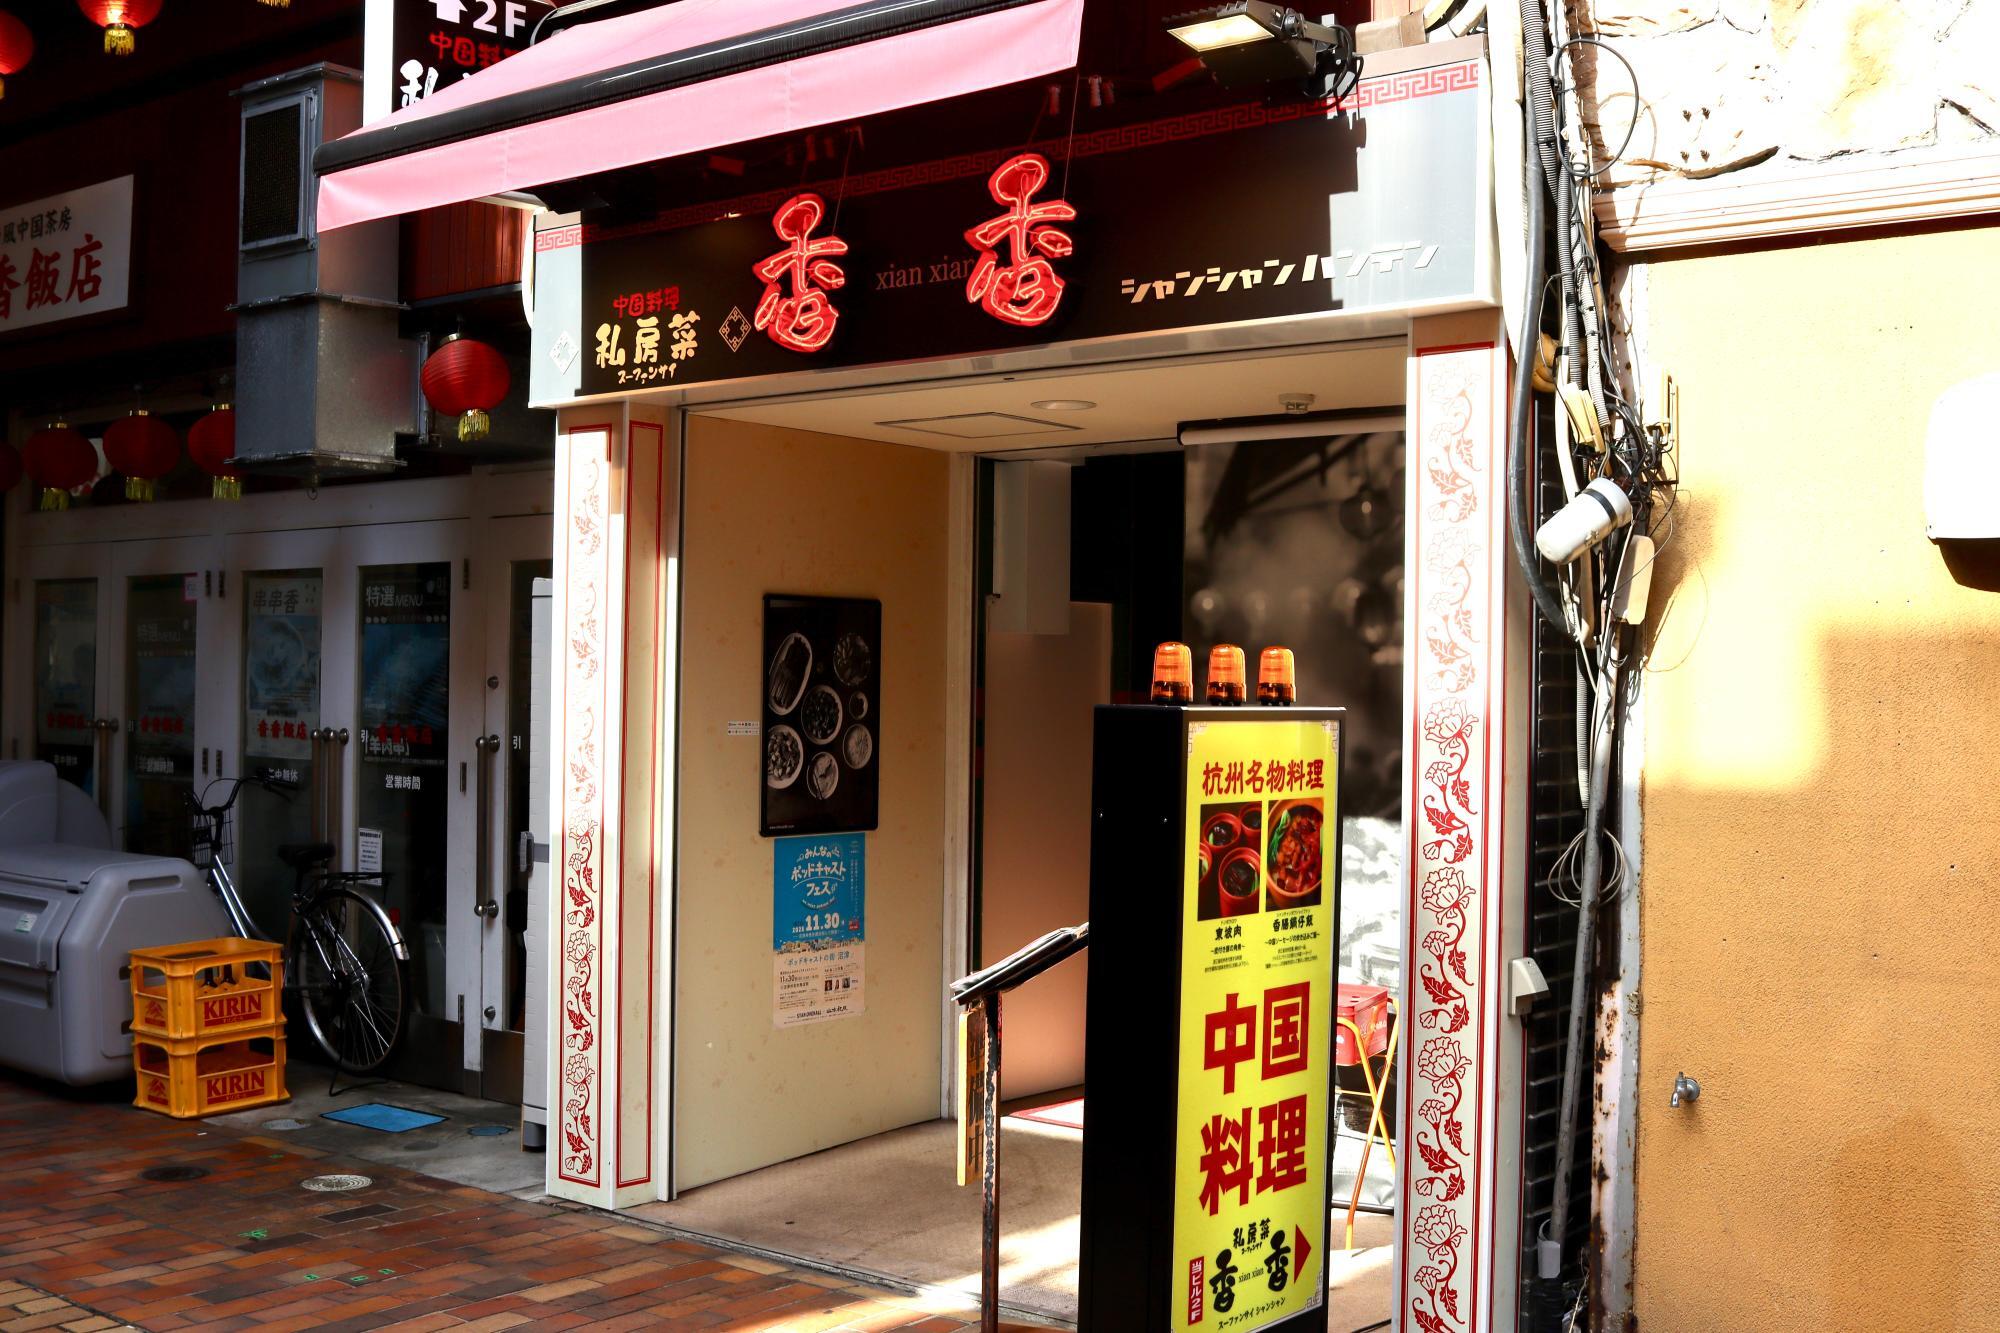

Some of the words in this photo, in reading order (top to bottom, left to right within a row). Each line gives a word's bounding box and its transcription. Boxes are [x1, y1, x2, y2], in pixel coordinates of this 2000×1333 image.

[472, 0, 527, 38] 2F
[0, 206, 73, 244] 風中国茶房
[752, 191, 849, 353] 香
[875, 263, 923, 291] xian
[965, 153, 1076, 326] 香
[1121, 240, 1440, 304] シャンシャンハンテン
[613, 285, 681, 319] 中国料理
[595, 310, 701, 369] 私房菜
[617, 363, 678, 385] スーファンサイ
[253, 588, 299, 614] 串串香
[366, 584, 395, 607] 特選
[395, 593, 424, 608] MENU
[257, 719, 308, 741] 香香飯店
[385, 774, 421, 792] 営業時間
[1202, 759, 1325, 797] 杭州名物料理
[791, 861, 847, 882] ポッドキャスト
[806, 881, 832, 897] フェス
[805, 912, 840, 931] 11.30
[1215, 924, 1242, 941] 東坡肉
[204, 992, 262, 1020] KIRIN
[1204, 981, 1310, 1095] 中国
[207, 1070, 264, 1098] KIRIN
[1199, 1094, 1308, 1217] 料理
[1233, 1217, 1271, 1249] 私房菜
[1209, 1248, 1238, 1313] 香
[1264, 1230, 1291, 1292] 香
[1190, 1259, 1203, 1321] 当ビル2F
[1218, 1309, 1255, 1331] スーファンサイ
[1256, 1296, 1286, 1315] シャンシャン
